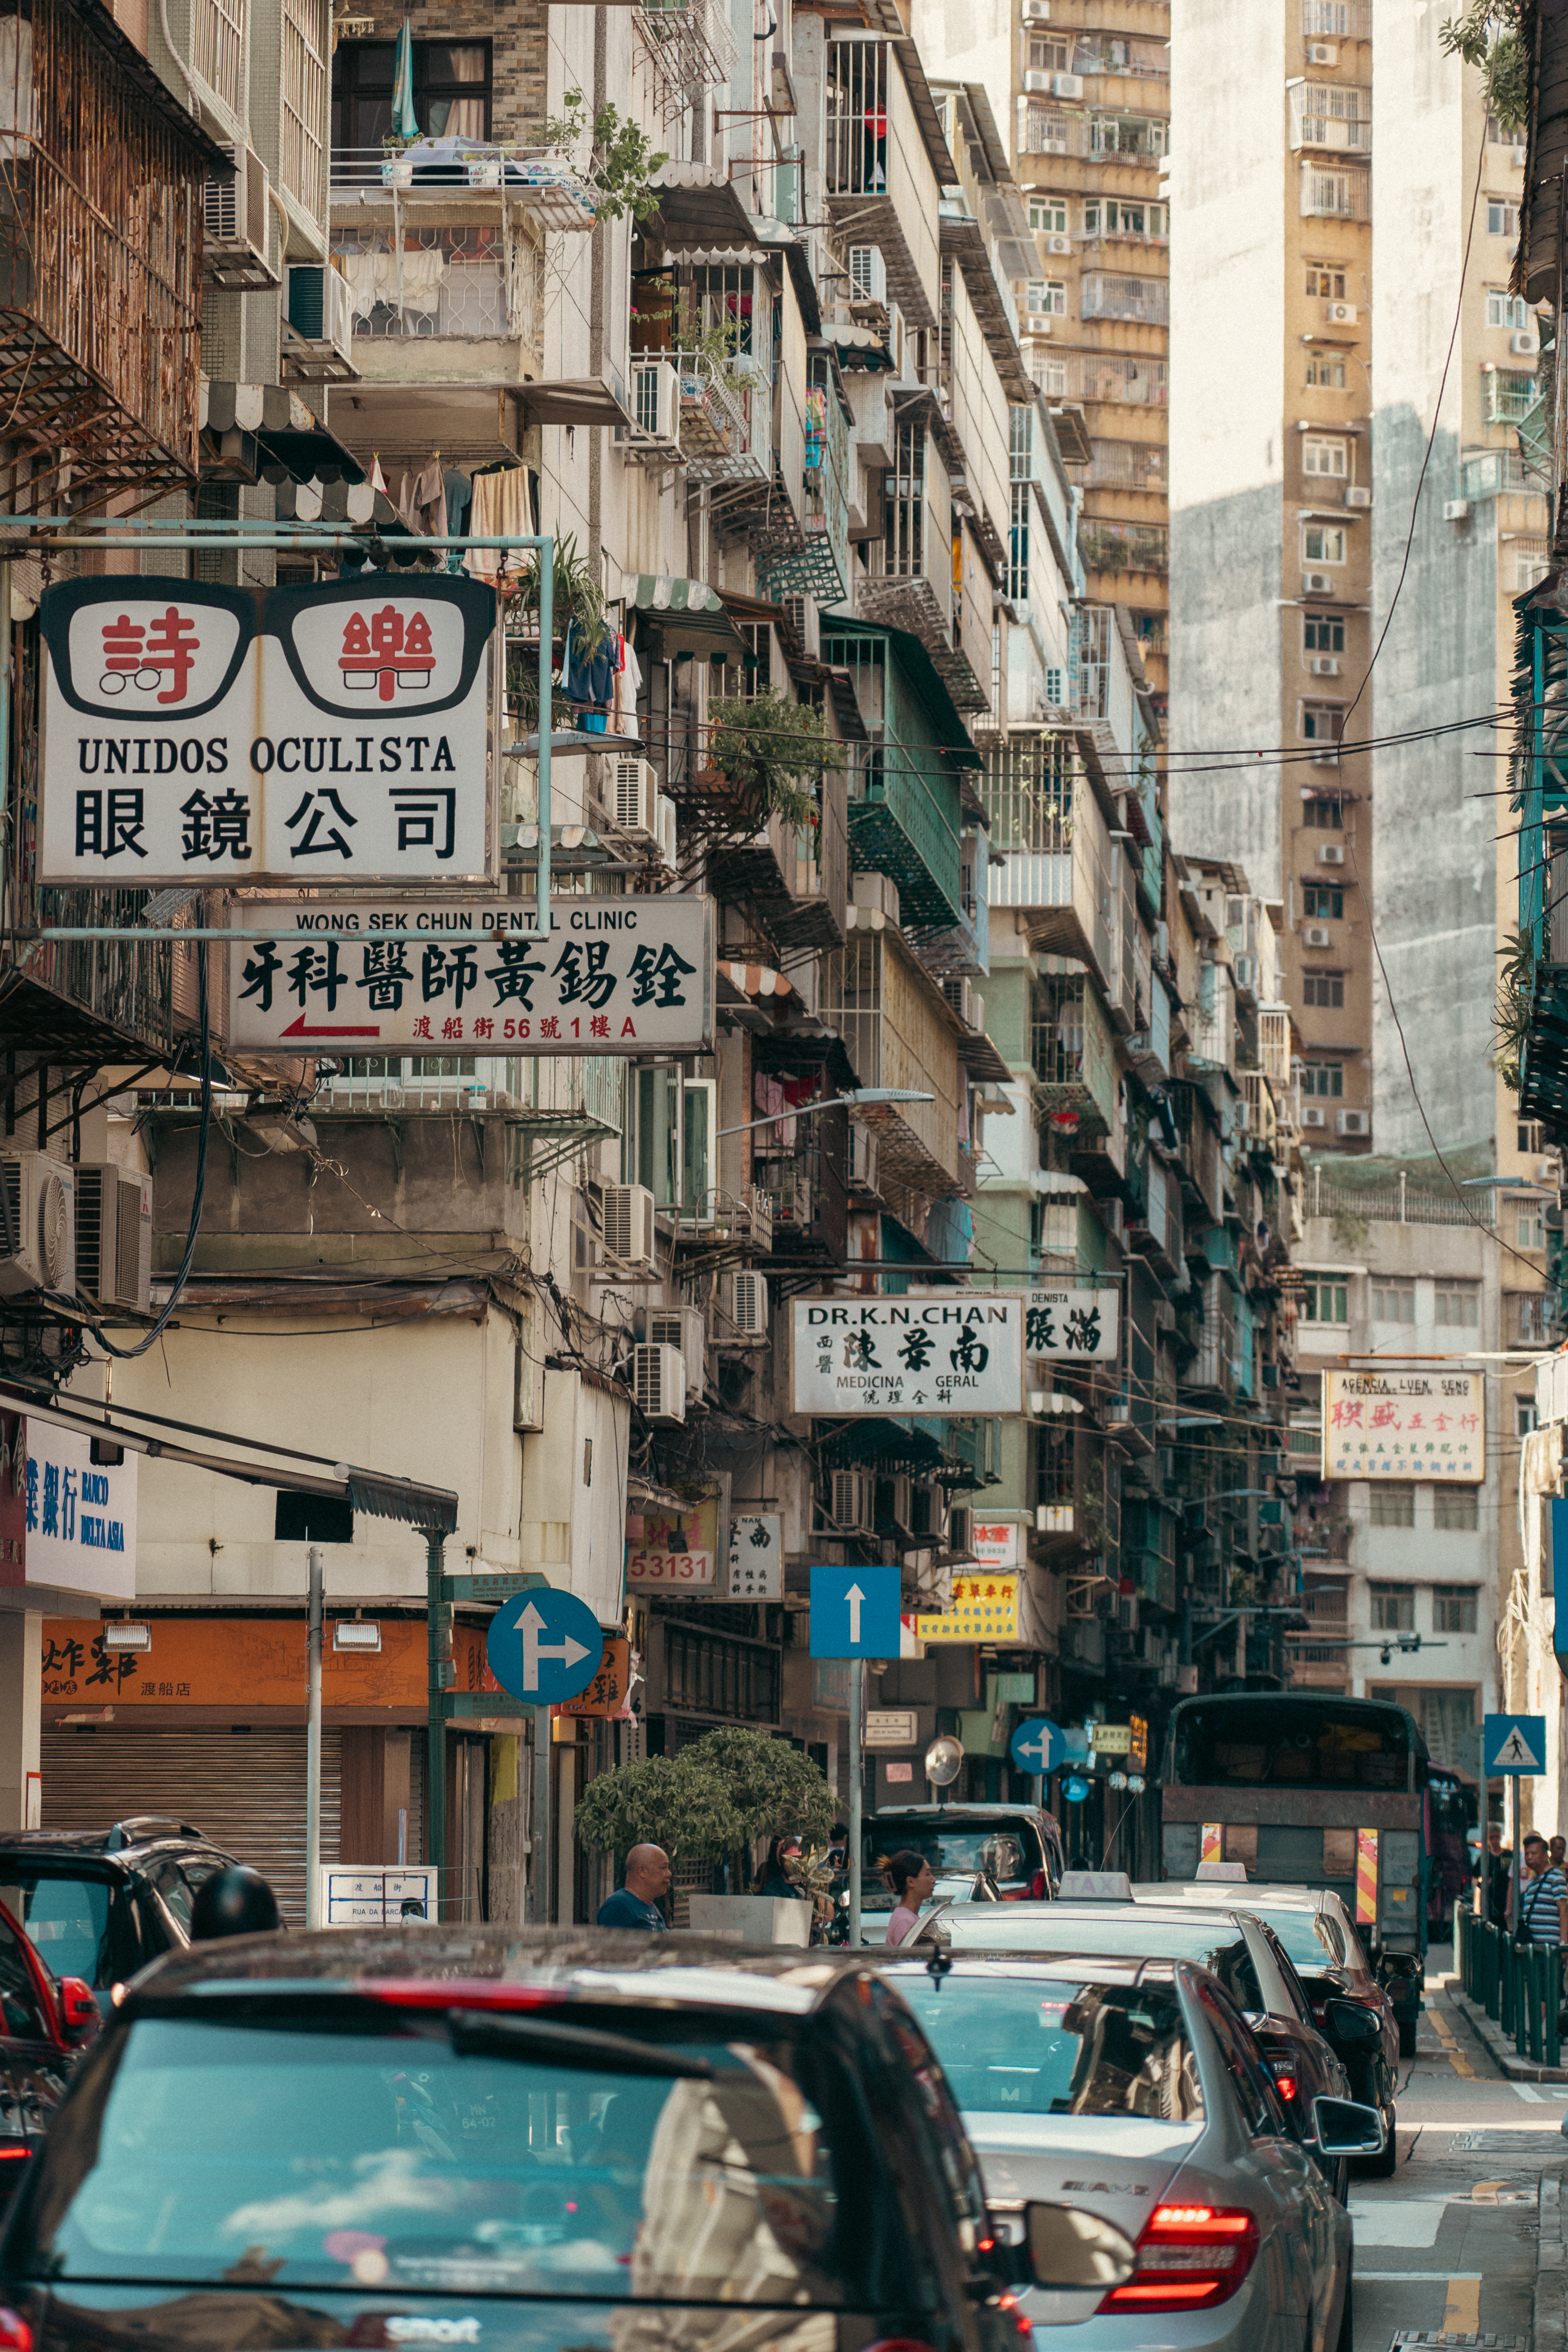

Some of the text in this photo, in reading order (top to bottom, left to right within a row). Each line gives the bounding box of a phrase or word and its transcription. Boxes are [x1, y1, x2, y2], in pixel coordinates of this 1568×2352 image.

[78, 736, 456, 774] UNIDOS OCULISTA
[75, 787, 456, 861] 眼鏡公司
[296, 911, 637, 930] WONG SEK CHUN DENTL CLINIC
[237, 940, 697, 1012] 牙科醫師黃錫銓
[1032, 1293, 1068, 1303] DENISTA
[816, 1335, 833, 1374] 西醫
[843, 1324, 989, 1373] 陳景南
[837, 1376, 979, 1388] MEDICINA GERAL
[1400, 1379, 1429, 1389] LUEN
[1441, 1380, 1469, 1390] SENG
[81, 1471, 109, 1506] BANCO
[81, 1514, 125, 1552] DELTA ASIA
[626, 1555, 707, 1578] 53131
[141, 1681, 191, 1696] 渡船店
[1201, 1864, 1242, 1878] TAXI
[354, 1883, 402, 1892] 渡船街
[1067, 1875, 1124, 1894] TAXI
